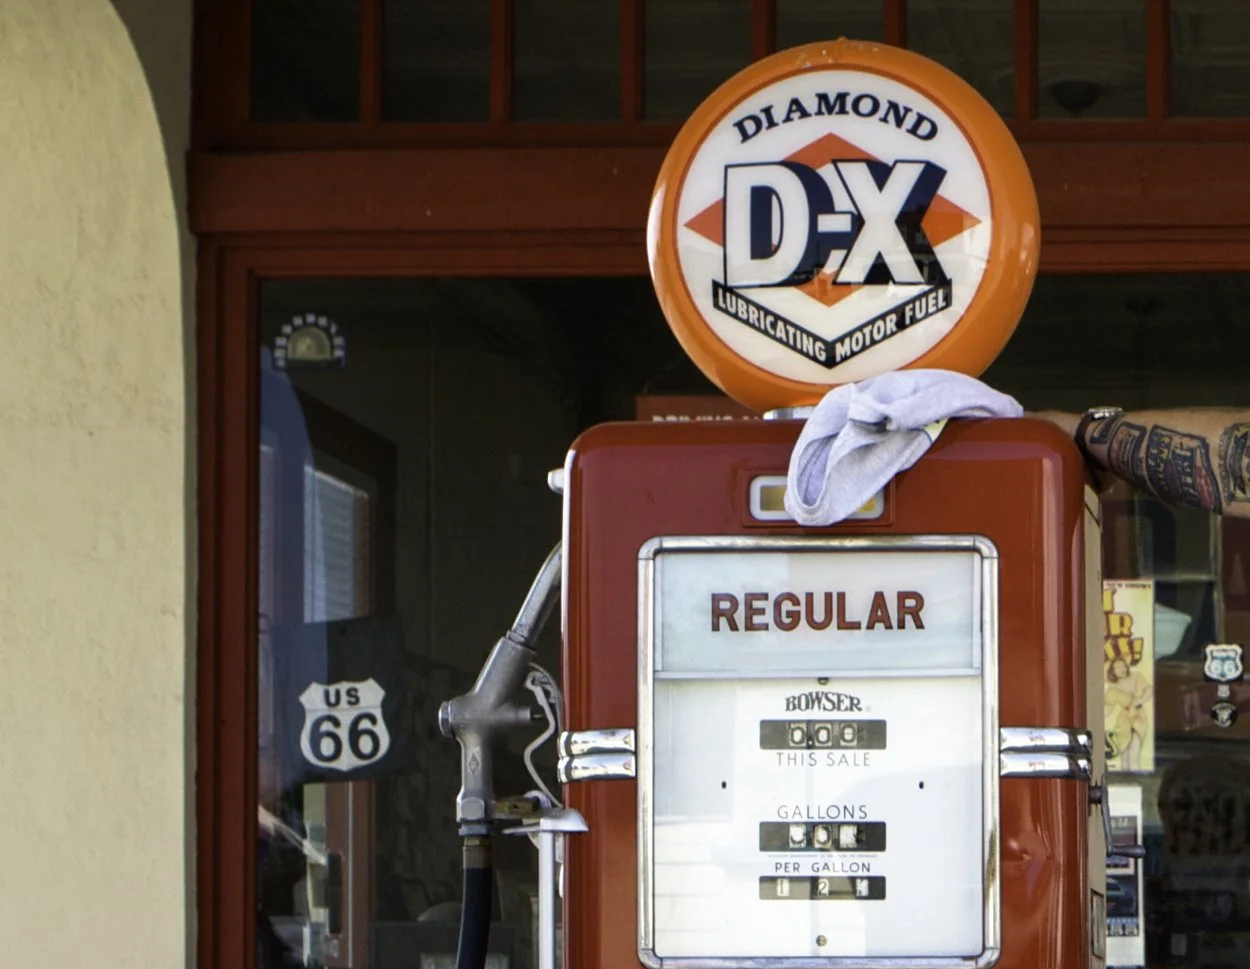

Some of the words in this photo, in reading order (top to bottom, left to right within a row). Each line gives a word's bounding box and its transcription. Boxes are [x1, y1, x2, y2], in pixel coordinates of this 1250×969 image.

[733, 92, 938, 143] DIAMOND
[724, 159, 947, 288] D-X
[717, 288, 827, 363] LUBRICATING
[835, 312, 898, 363] MOTOR
[904, 288, 947, 325] FUEL
[711, 591, 926, 631] REGULAR
[323, 686, 361, 708] US
[785, 691, 862, 712] BOWSER
[309, 711, 381, 763] 66
[776, 752, 817, 767] THIS
[827, 752, 870, 767] SALE
[777, 804, 868, 819] GALLONS
[775, 862, 800, 873] PER
[811, 862, 871, 873] GALLON
